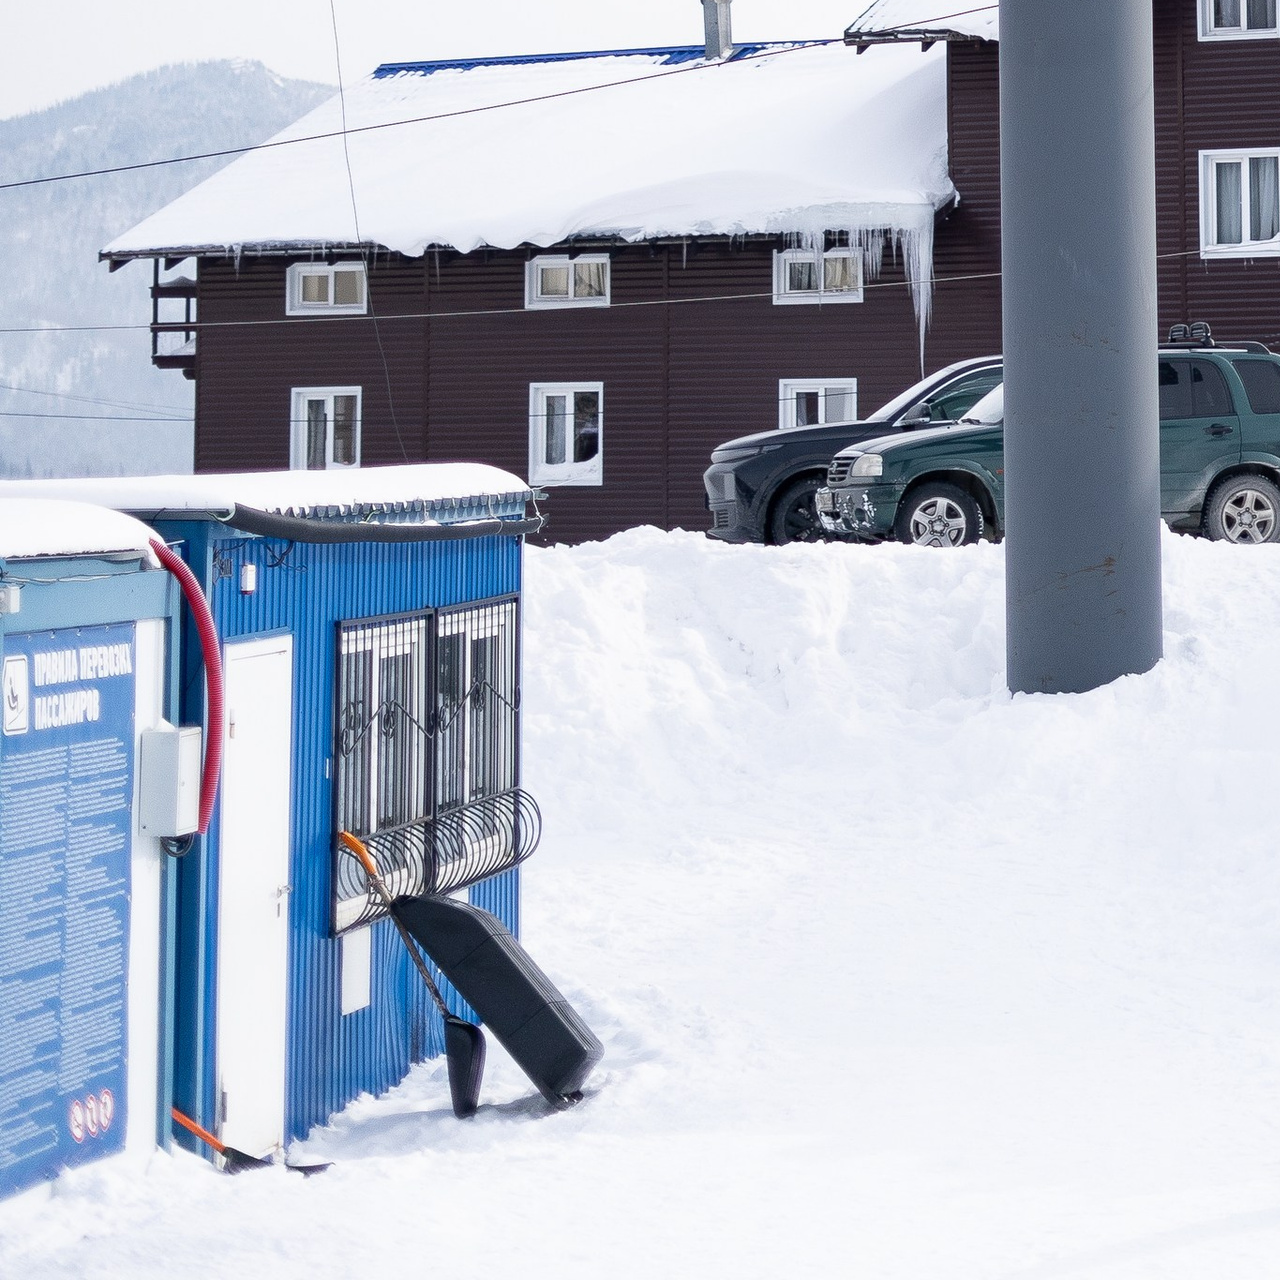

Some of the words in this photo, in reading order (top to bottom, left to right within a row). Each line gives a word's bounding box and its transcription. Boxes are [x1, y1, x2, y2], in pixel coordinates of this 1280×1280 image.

[34, 649, 77, 686] ПРАВИЛА
[80, 643, 132, 680] ПЕРЕВОЗКИ
[34, 689, 100, 730] ПАССАЖИРОВ
